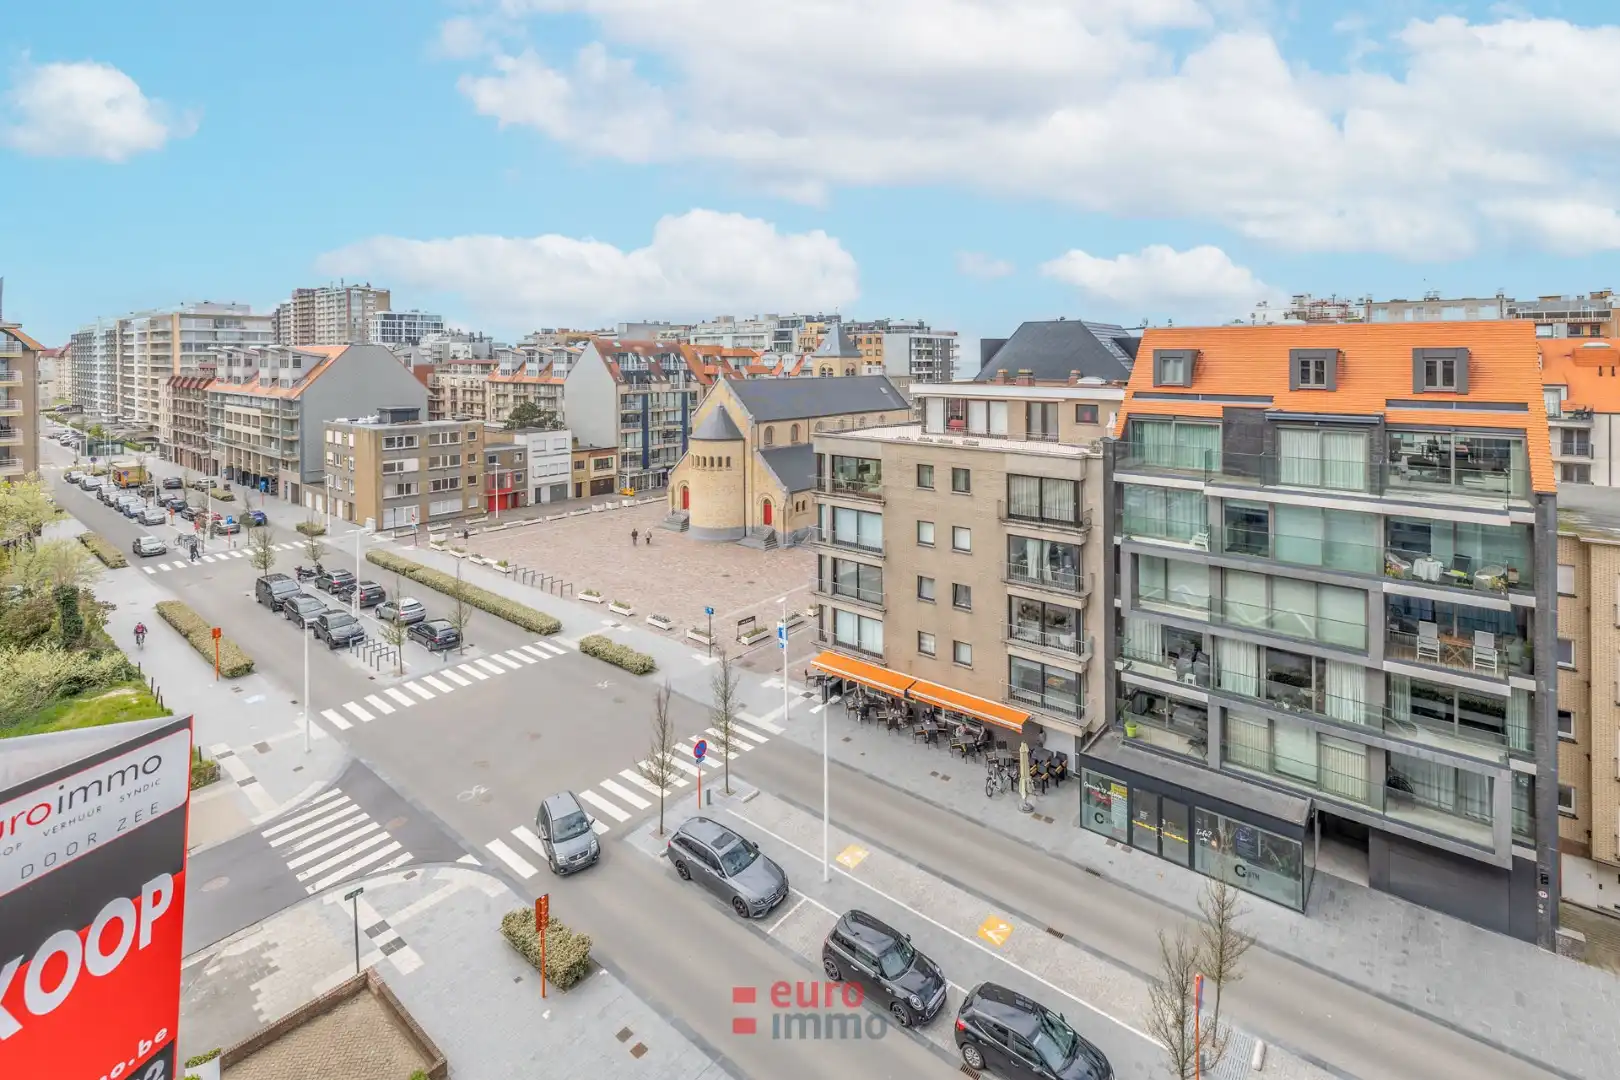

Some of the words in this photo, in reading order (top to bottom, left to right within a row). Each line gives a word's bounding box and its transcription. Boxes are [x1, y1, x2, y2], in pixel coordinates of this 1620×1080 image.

[43, 805, 102, 837] VERHUUR
[119, 778, 161, 803] SYNDIC
[21, 832, 97, 879] DOOR
[117, 802, 160, 832] ZEE
[99, 1028, 168, 1080] o.be
